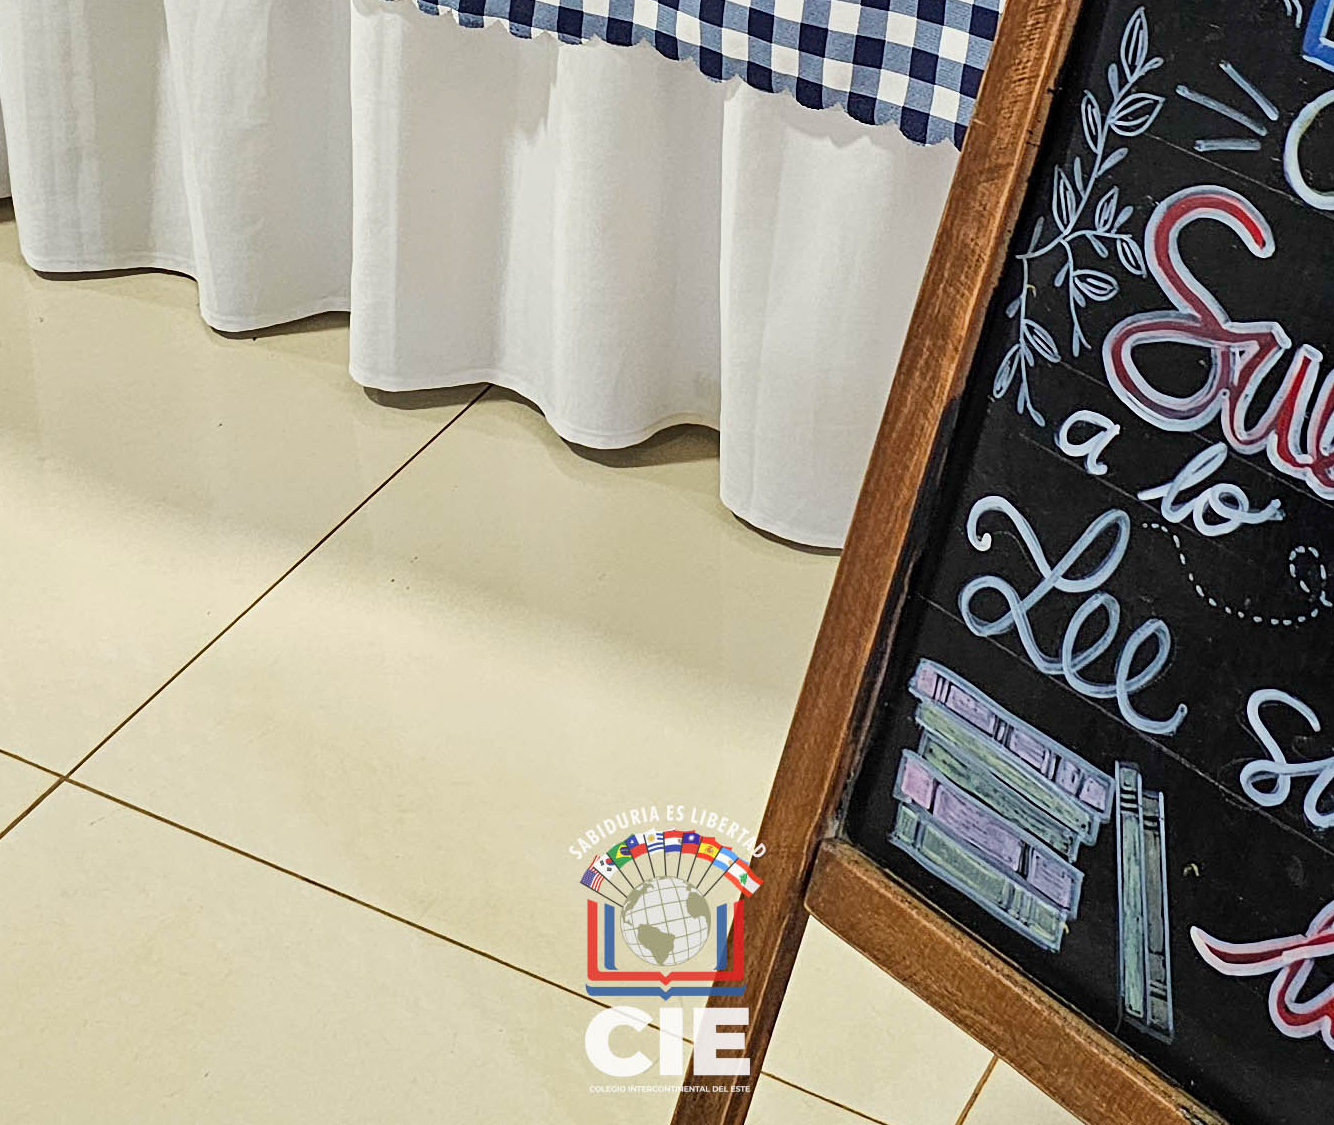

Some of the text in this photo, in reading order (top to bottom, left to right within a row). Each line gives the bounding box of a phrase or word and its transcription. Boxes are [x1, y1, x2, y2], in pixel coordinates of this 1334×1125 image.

[1054, 410, 1288, 537] a lo
[958, 496, 1189, 735] Lee
